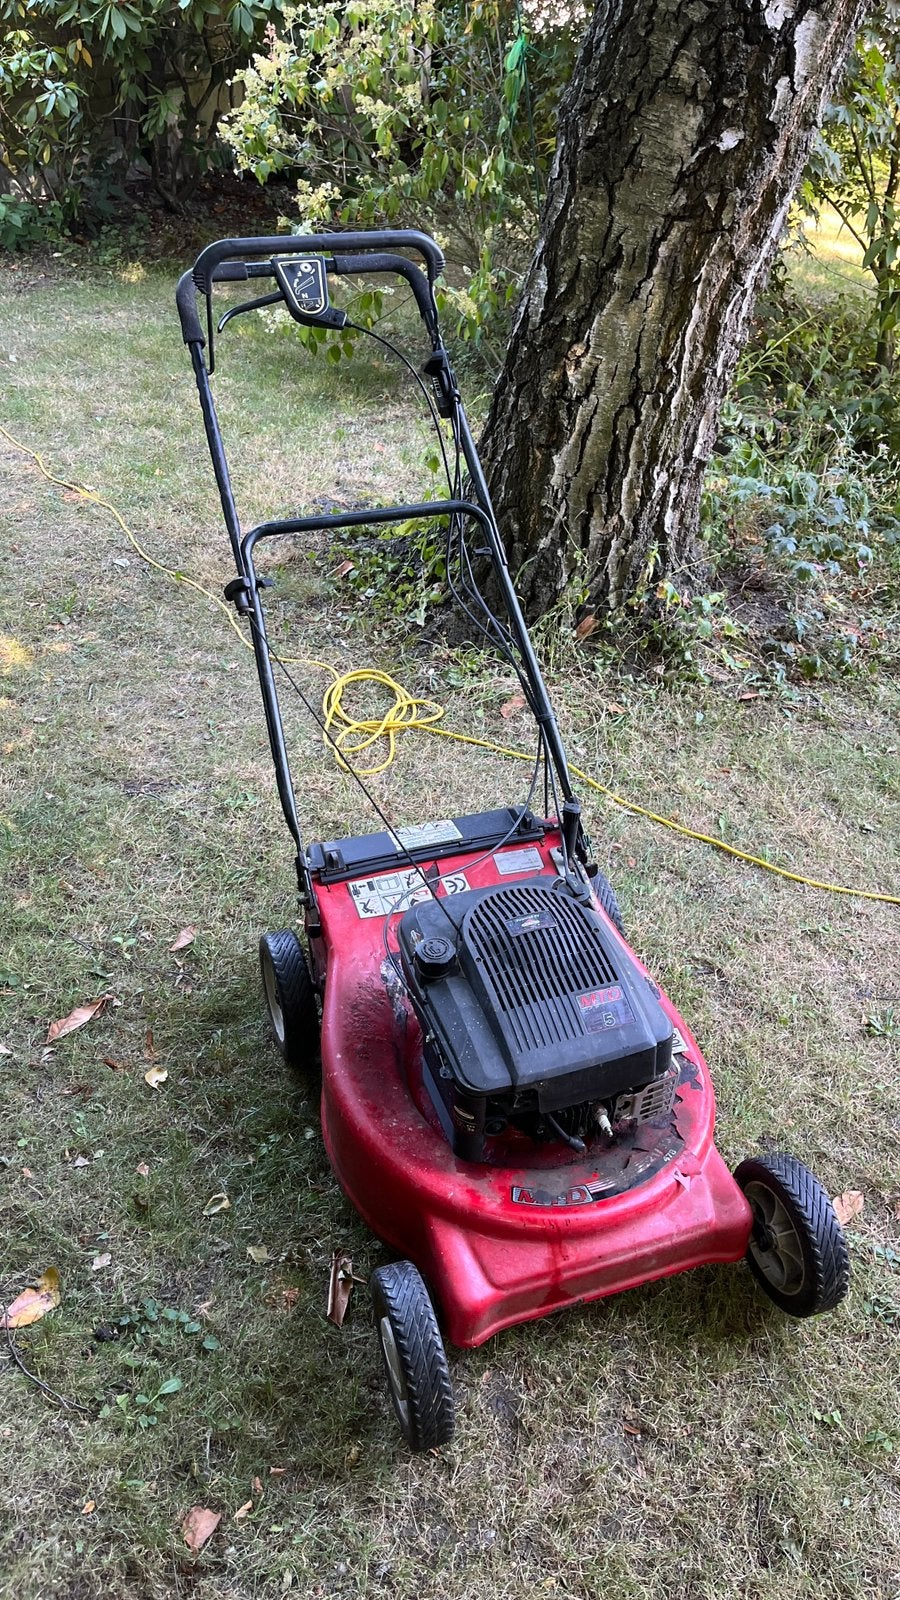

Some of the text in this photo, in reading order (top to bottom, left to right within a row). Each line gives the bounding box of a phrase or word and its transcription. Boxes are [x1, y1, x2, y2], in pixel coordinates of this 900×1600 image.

[580, 985, 621, 1007] MTD
[603, 1011, 616, 1027] 5
[516, 1186, 588, 1204] MD
